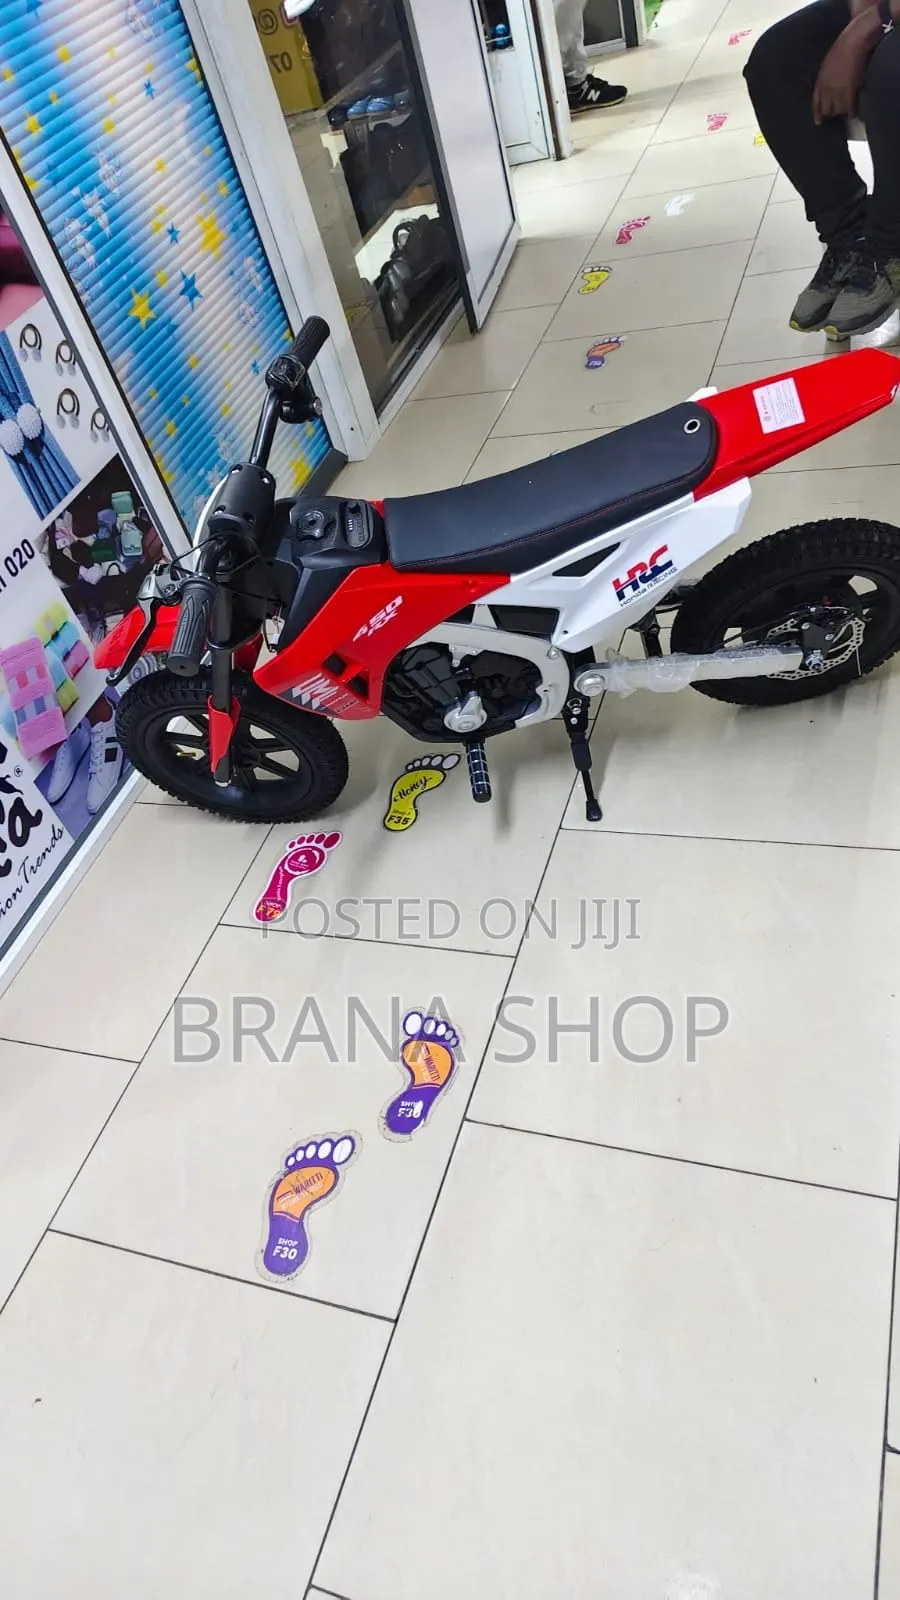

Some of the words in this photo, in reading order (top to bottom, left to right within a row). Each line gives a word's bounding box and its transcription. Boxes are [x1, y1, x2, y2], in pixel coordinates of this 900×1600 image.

[612, 544, 673, 601] HRC
[352, 595, 403, 642] 450
[387, 815, 411, 825] F35
[18, 824, 64, 883] Trends
[272, 1245, 298, 1260] F30
[278, 1238, 299, 1247] SHOP
